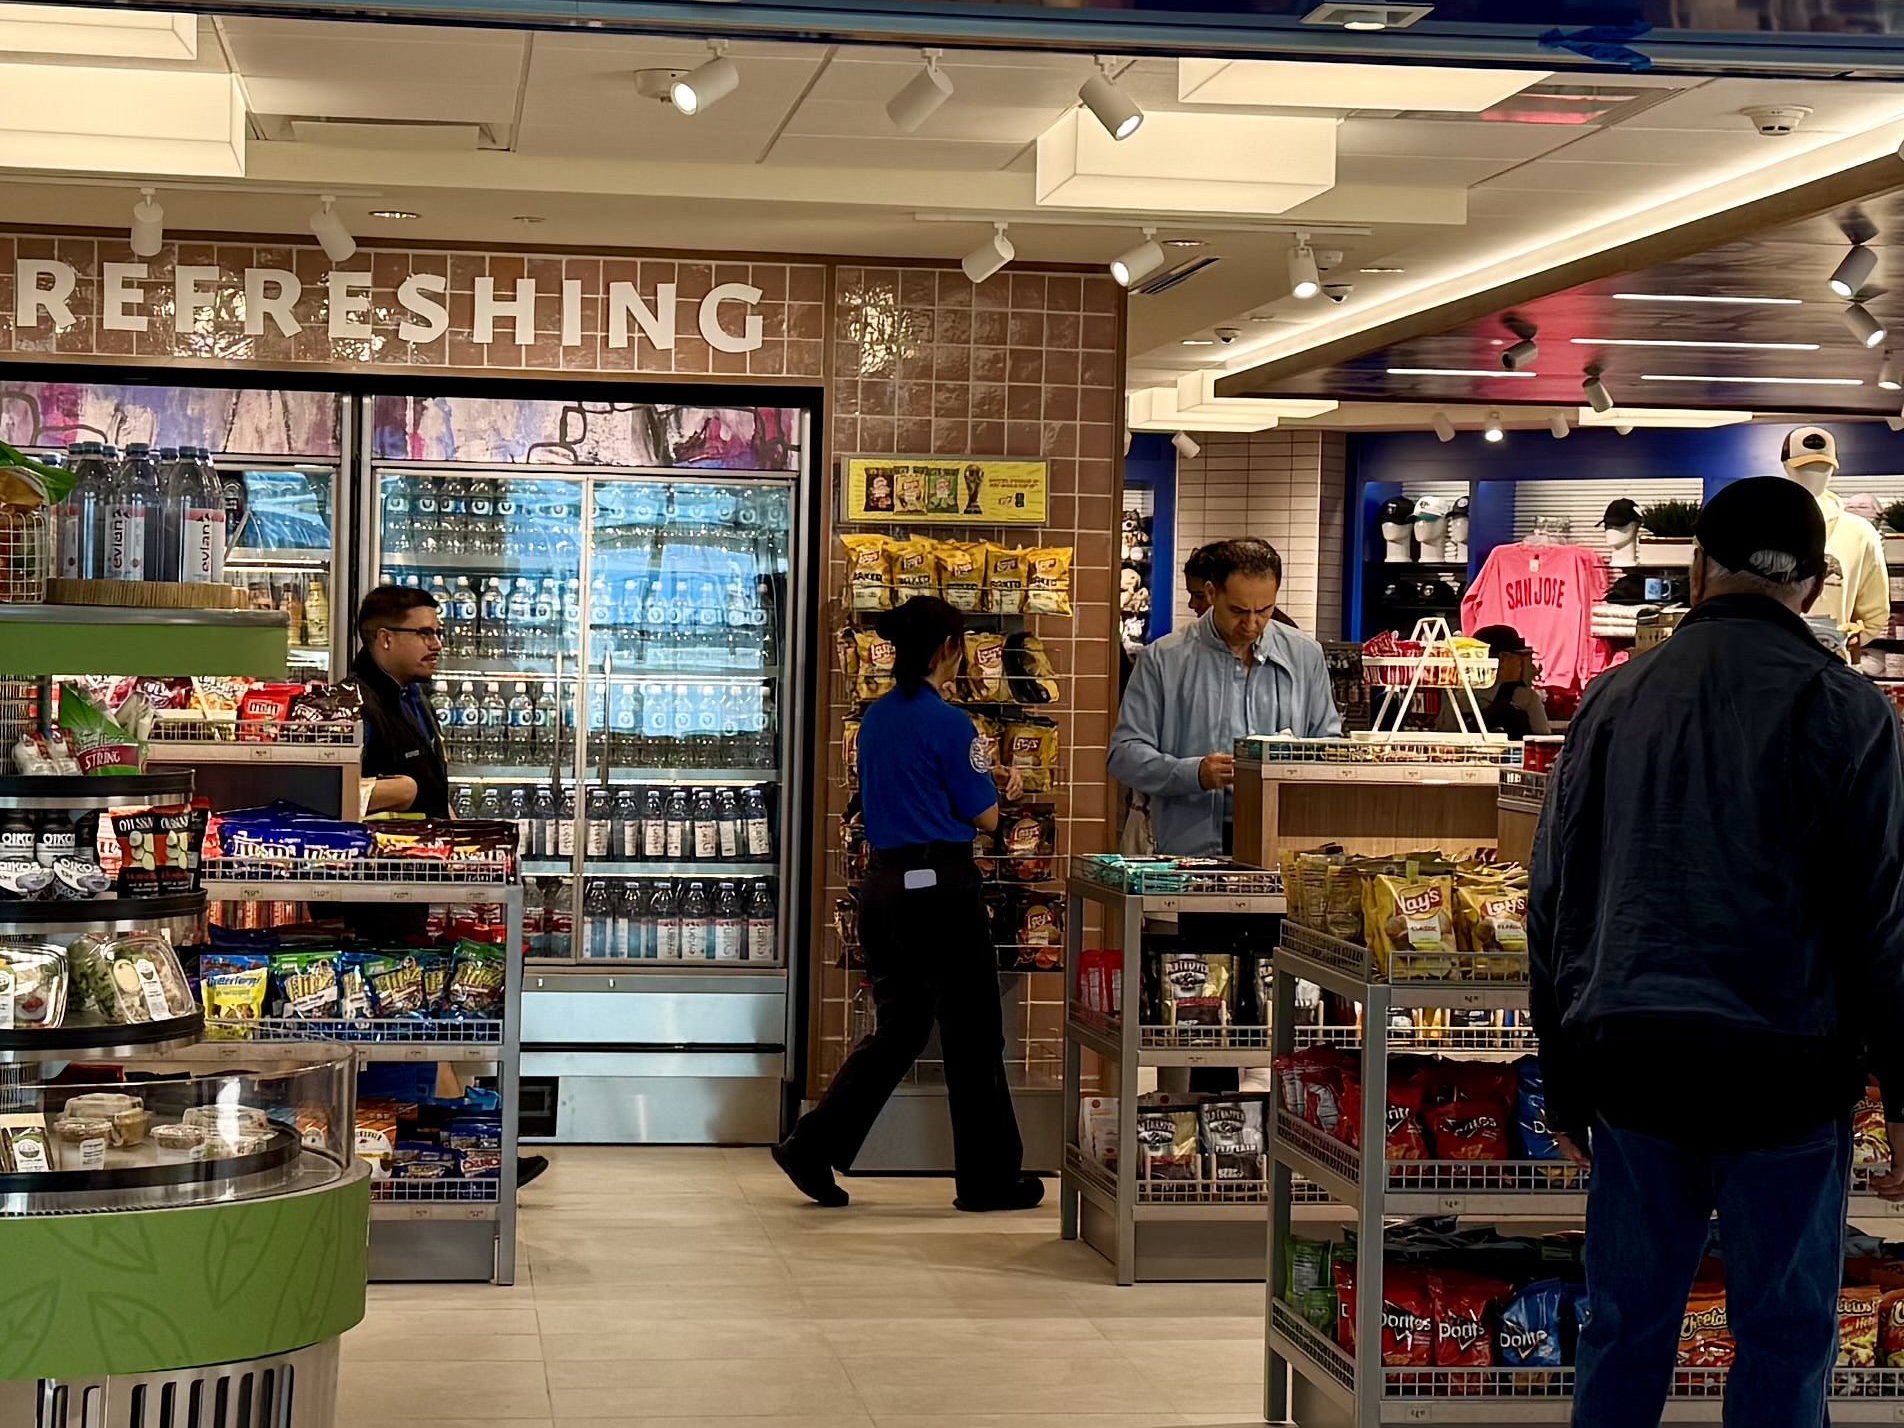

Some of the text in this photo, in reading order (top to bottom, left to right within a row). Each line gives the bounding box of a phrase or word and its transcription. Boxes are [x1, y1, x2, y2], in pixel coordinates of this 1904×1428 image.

[15, 257, 765, 354] REFRESHING
[201, 514, 213, 573] evian
[1506, 579, 1566, 610] SAN JOSE
[84, 750, 121, 771] STRING
[1400, 889, 1442, 915] Lay's
